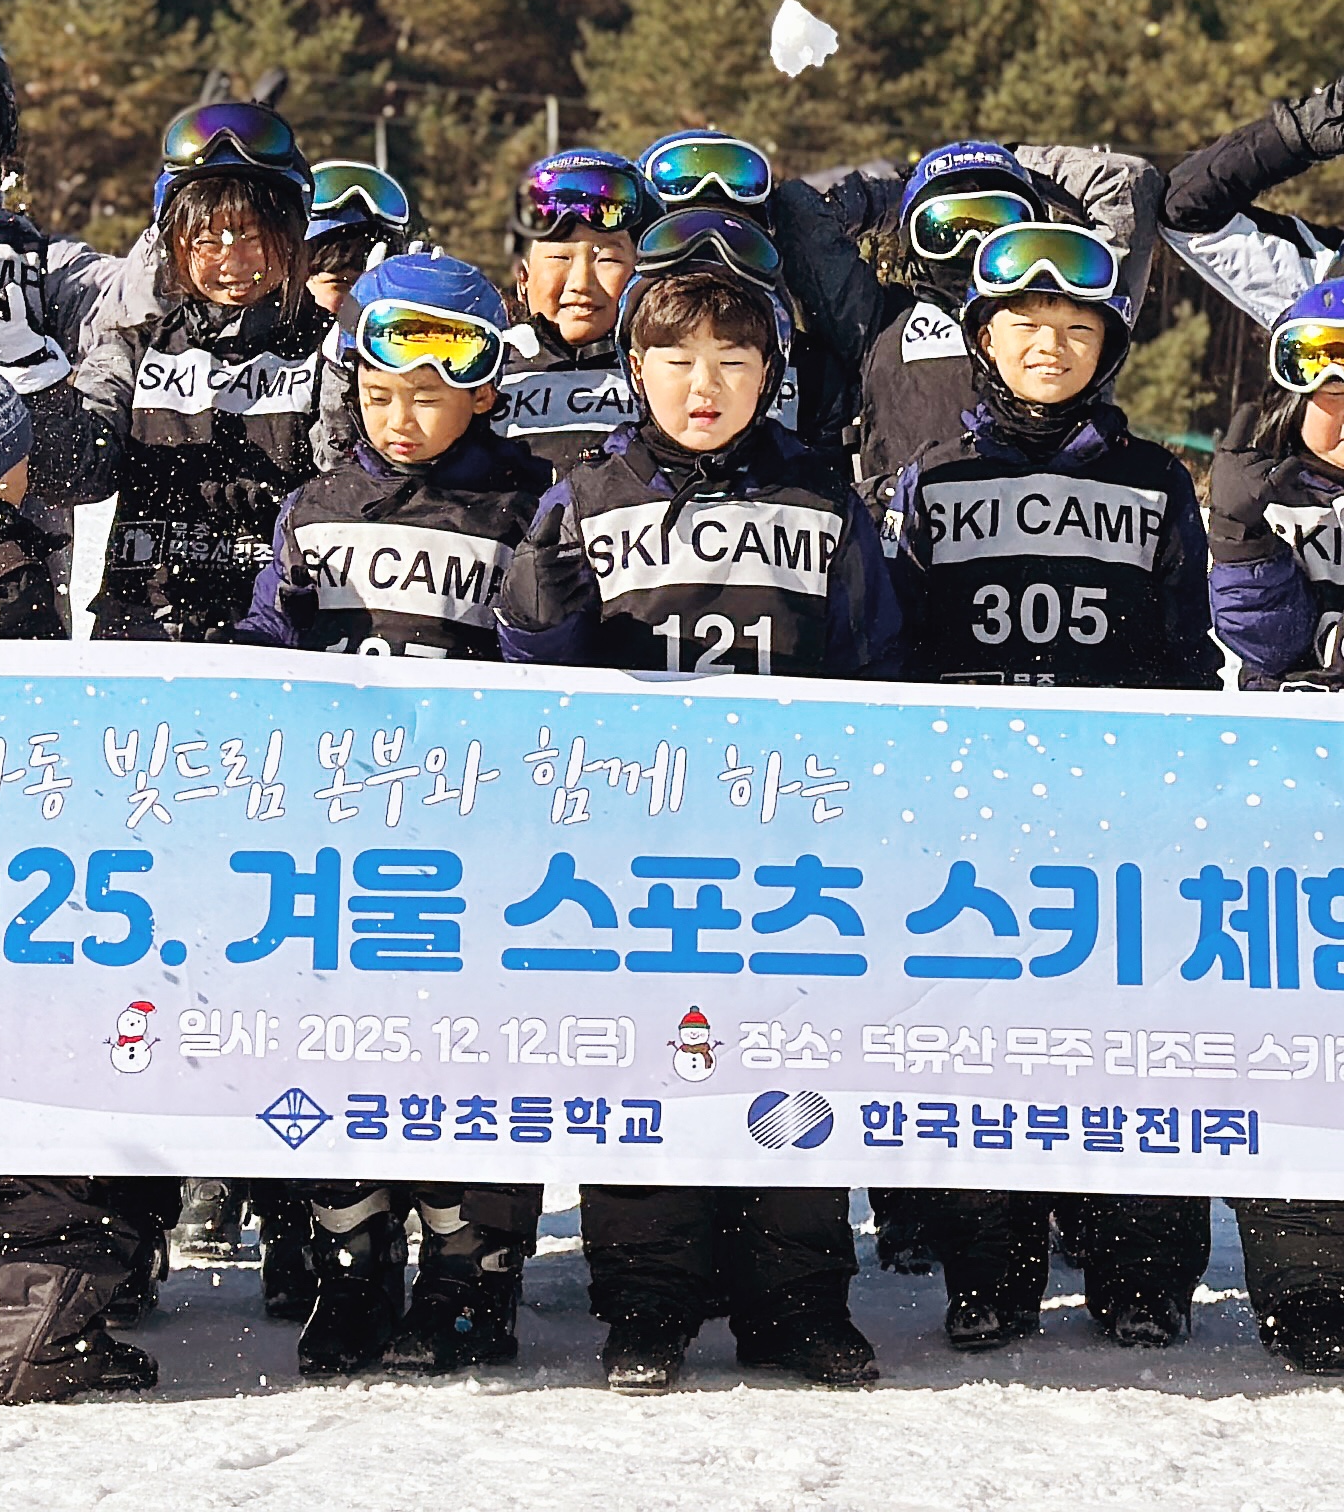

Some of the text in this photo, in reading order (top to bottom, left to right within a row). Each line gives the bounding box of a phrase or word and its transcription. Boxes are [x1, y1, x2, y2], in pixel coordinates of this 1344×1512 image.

[138, 362, 312, 400] SKI CAMP
[587, 519, 840, 579] SKI CAMP
[928, 493, 1164, 548] SKI CAMP
[971, 582, 1108, 645] 305
[652, 613, 773, 676] 121
[103, 721, 285, 829] 빛드림
[314, 726, 500, 827] 본부와
[523, 725, 687, 825] 함께
[717, 743, 850, 824] 하는
[225, 846, 467, 973] 겨울
[500, 851, 868, 977] 스포츠
[903, 859, 1144, 986] 스키
[178, 1008, 280, 1058] 일시:
[297, 1014, 422, 1063] 2025.
[431, 1015, 490, 1064] 12.
[738, 1020, 843, 1069] 장소:
[861, 1023, 998, 1074] 덕유산
[1004, 1027, 1095, 1076] 무주
[1104, 1029, 1239, 1079] 리조트
[344, 1093, 664, 1144] 궁항초등학교
